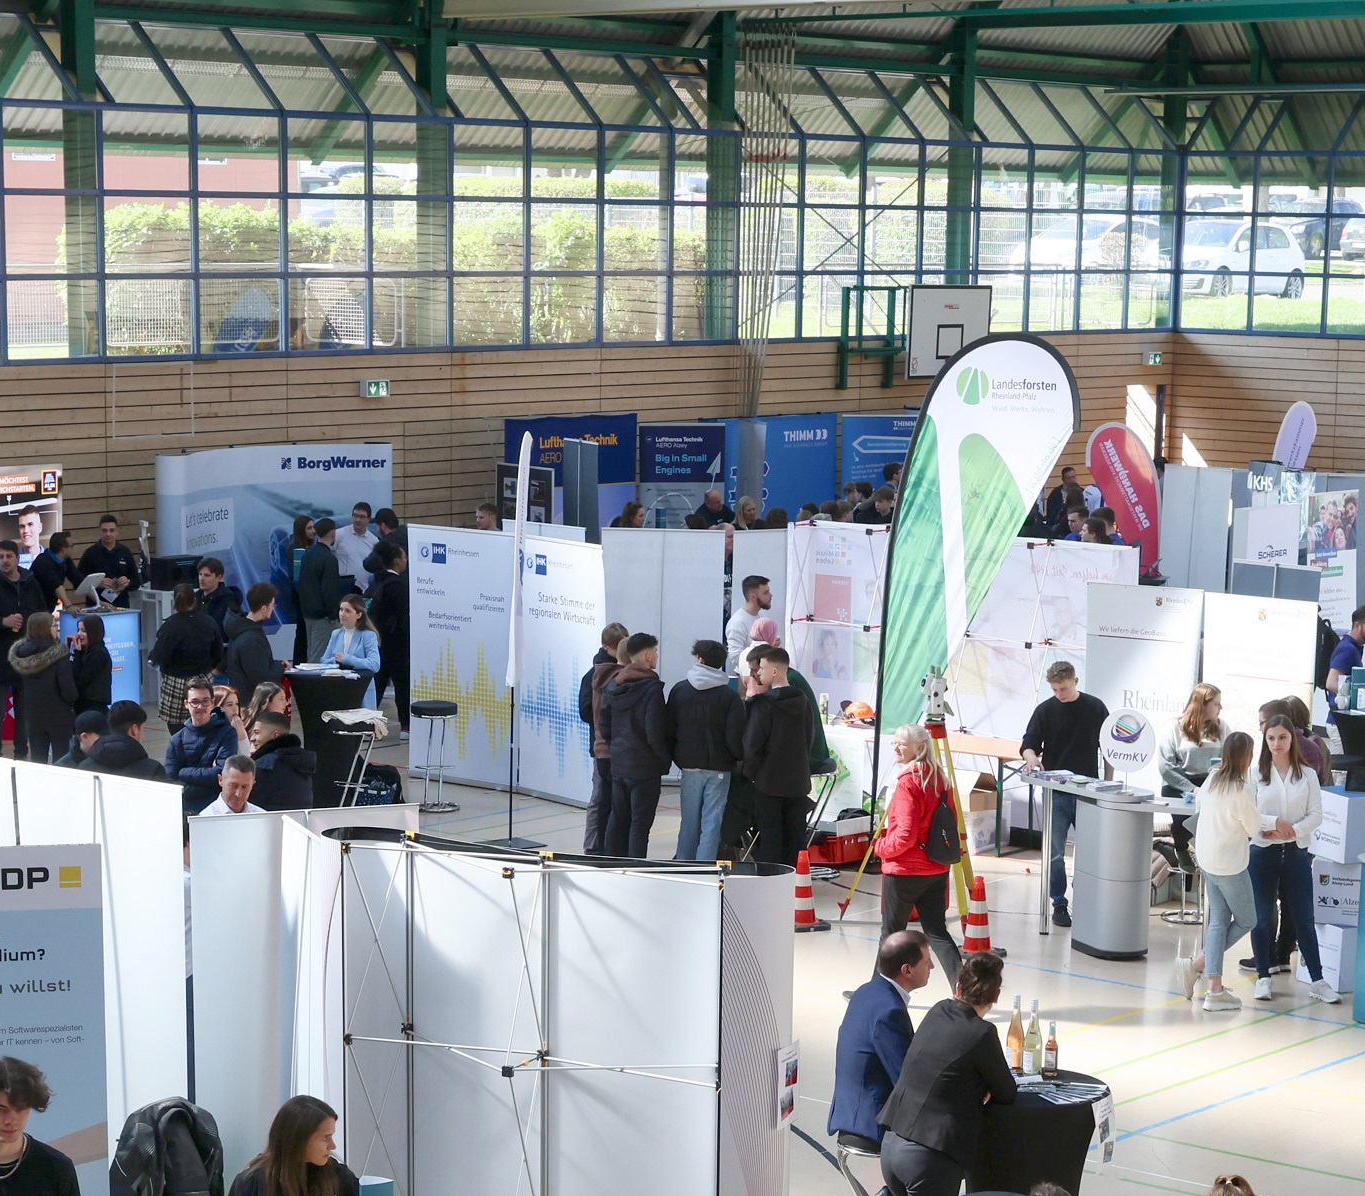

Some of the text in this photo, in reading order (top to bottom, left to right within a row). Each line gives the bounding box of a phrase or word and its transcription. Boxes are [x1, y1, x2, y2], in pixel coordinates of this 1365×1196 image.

[991, 378, 1057, 391] Landesforsten
[991, 392, 1037, 401] Rheinland-Pfalz
[783, 430, 814, 442] THIMM
[297, 455, 387, 472] BorgWarner
[655, 453, 707, 464] Big Small
[655, 465, 692, 476] Engines
[1252, 475, 1274, 491] KHS
[432, 545, 447, 555] IHK
[447, 547, 480, 558] Rheinhessen
[1257, 548, 1288, 560] SCHERER
[536, 557, 547, 567] IHK
[416, 576, 434, 586] Berufe
[416, 586, 446, 597] entwickeln
[479, 592, 505, 604] Praxisnah
[537, 591, 596, 612] Starke Stimme der
[428, 611, 472, 624] Bedarfsorientiert
[528, 606, 596, 627] regionalen Wirtschaft
[428, 621, 461, 632] weiterbilden
[1106, 748, 1148, 764] VermKV
[9, 979, 72, 994] willst!
[8, 1023, 84, 1035] Softwarespezialisten
